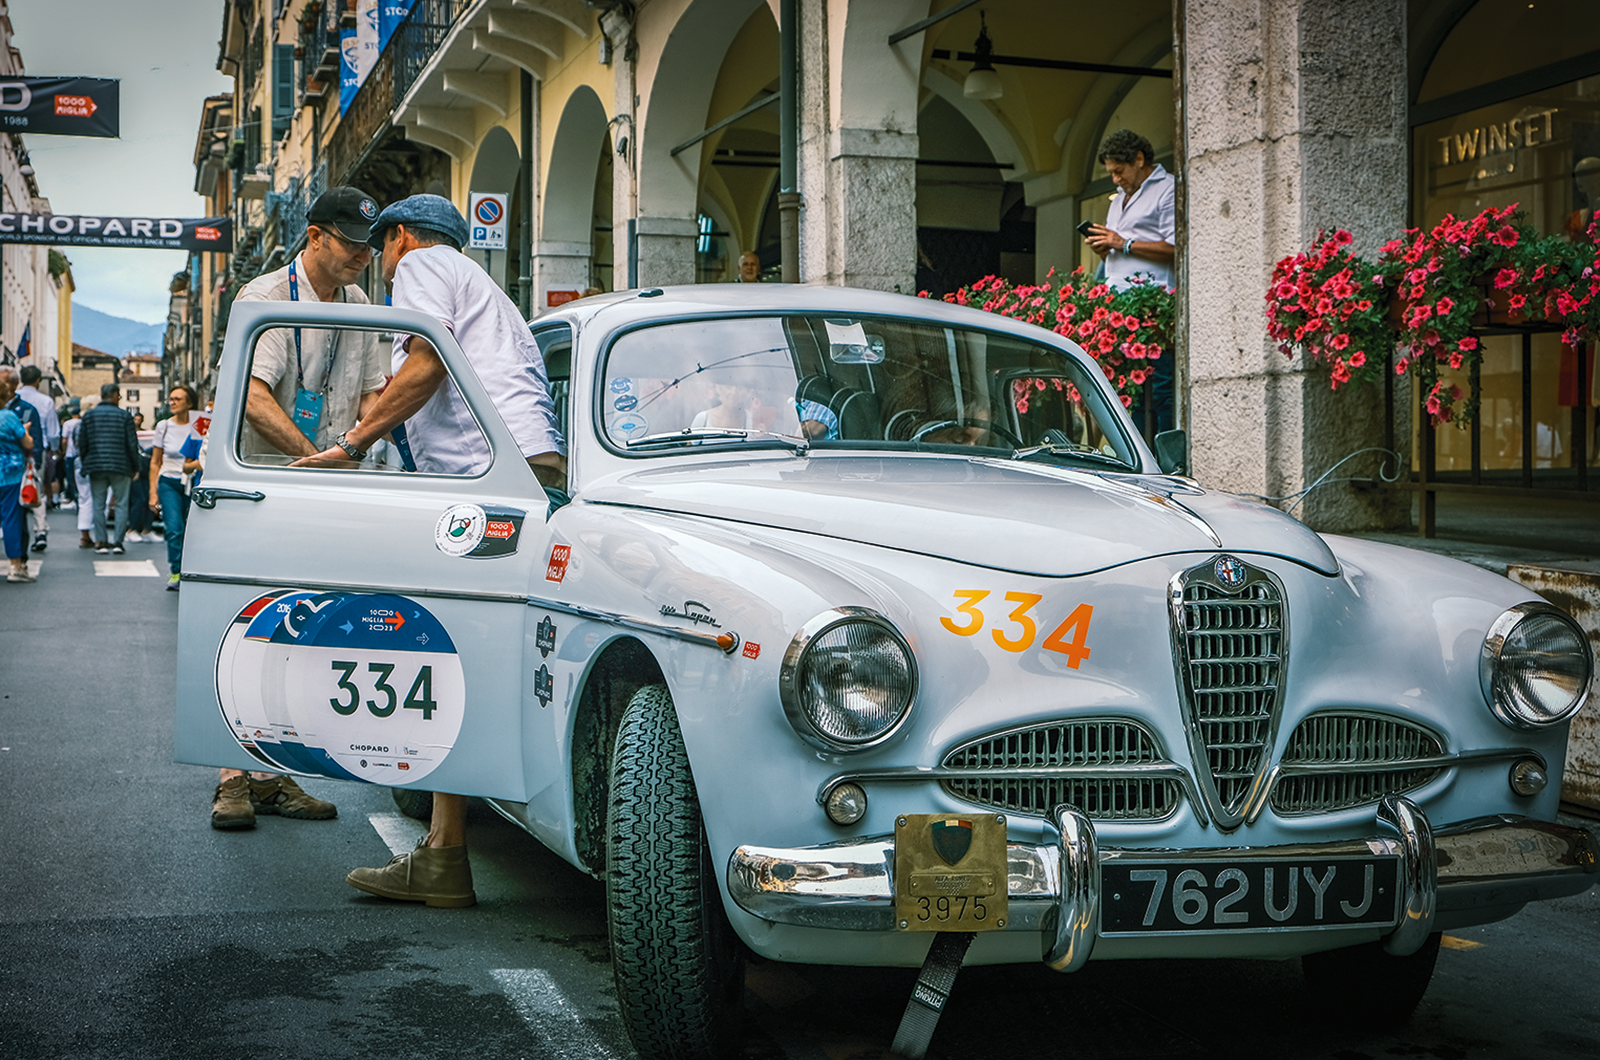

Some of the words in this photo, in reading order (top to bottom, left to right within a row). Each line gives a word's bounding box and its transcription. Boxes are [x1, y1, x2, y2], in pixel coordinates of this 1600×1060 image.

[56, 106, 88, 115] MIGLIA
[58, 97, 86, 106] 1000
[4, 116, 29, 127] 1988
[1438, 107, 1559, 166] TWINSET
[0, 213, 183, 238] CHOPARD
[553, 549, 568, 561] 1000
[276, 603, 292, 613] 2016
[939, 589, 1094, 670] 334
[329, 660, 438, 720] 334
[349, 744, 390, 753] CHOPARD
[1130, 867, 1250, 926] 762
[1263, 864, 1375, 923] UYJ
[917, 896, 988, 922] 3975
[914, 989, 942, 1009] PITKING
